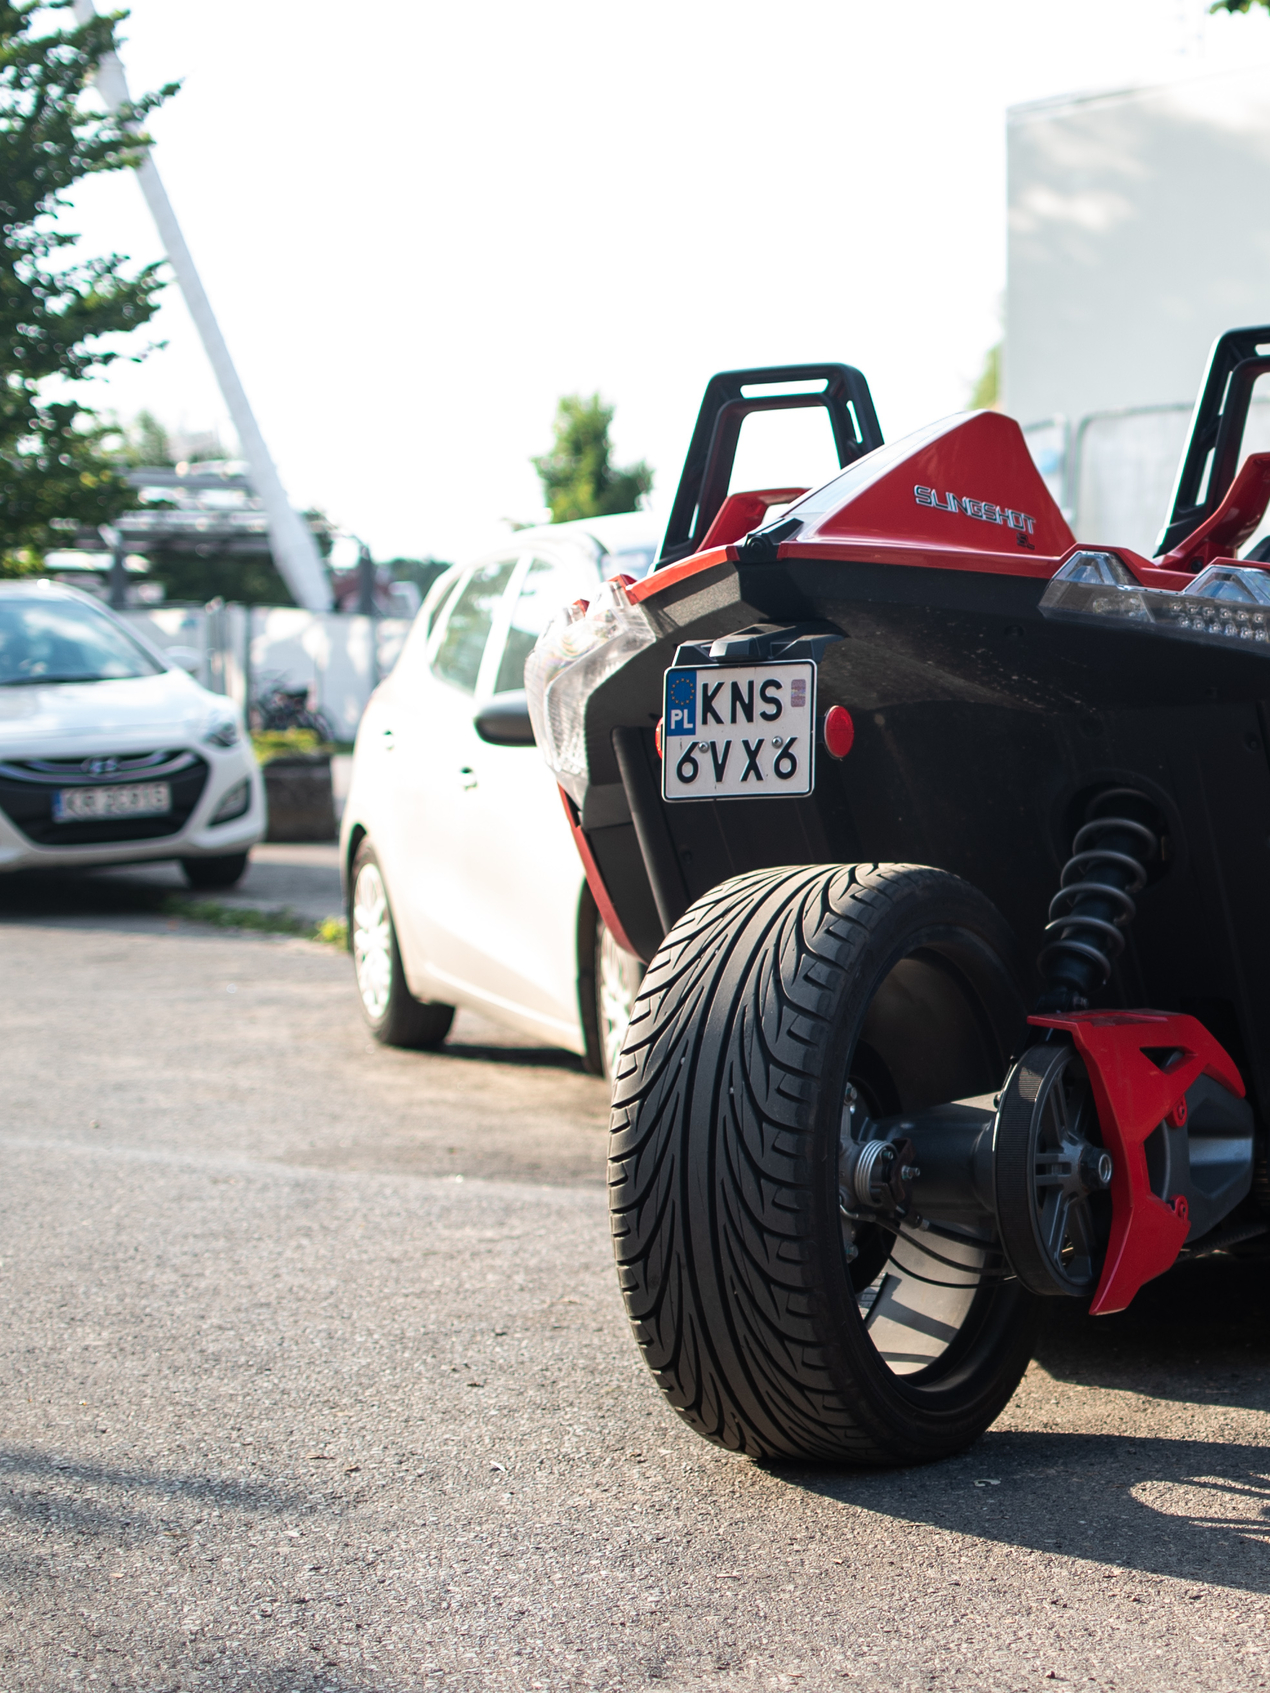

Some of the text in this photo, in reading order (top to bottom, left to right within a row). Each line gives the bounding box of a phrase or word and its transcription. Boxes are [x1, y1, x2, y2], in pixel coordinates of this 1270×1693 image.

[914, 484, 1036, 534] SLINGSHOT
[670, 709, 693, 729] PL
[701, 679, 783, 725] KNS
[676, 737, 798, 783] 6VX6
